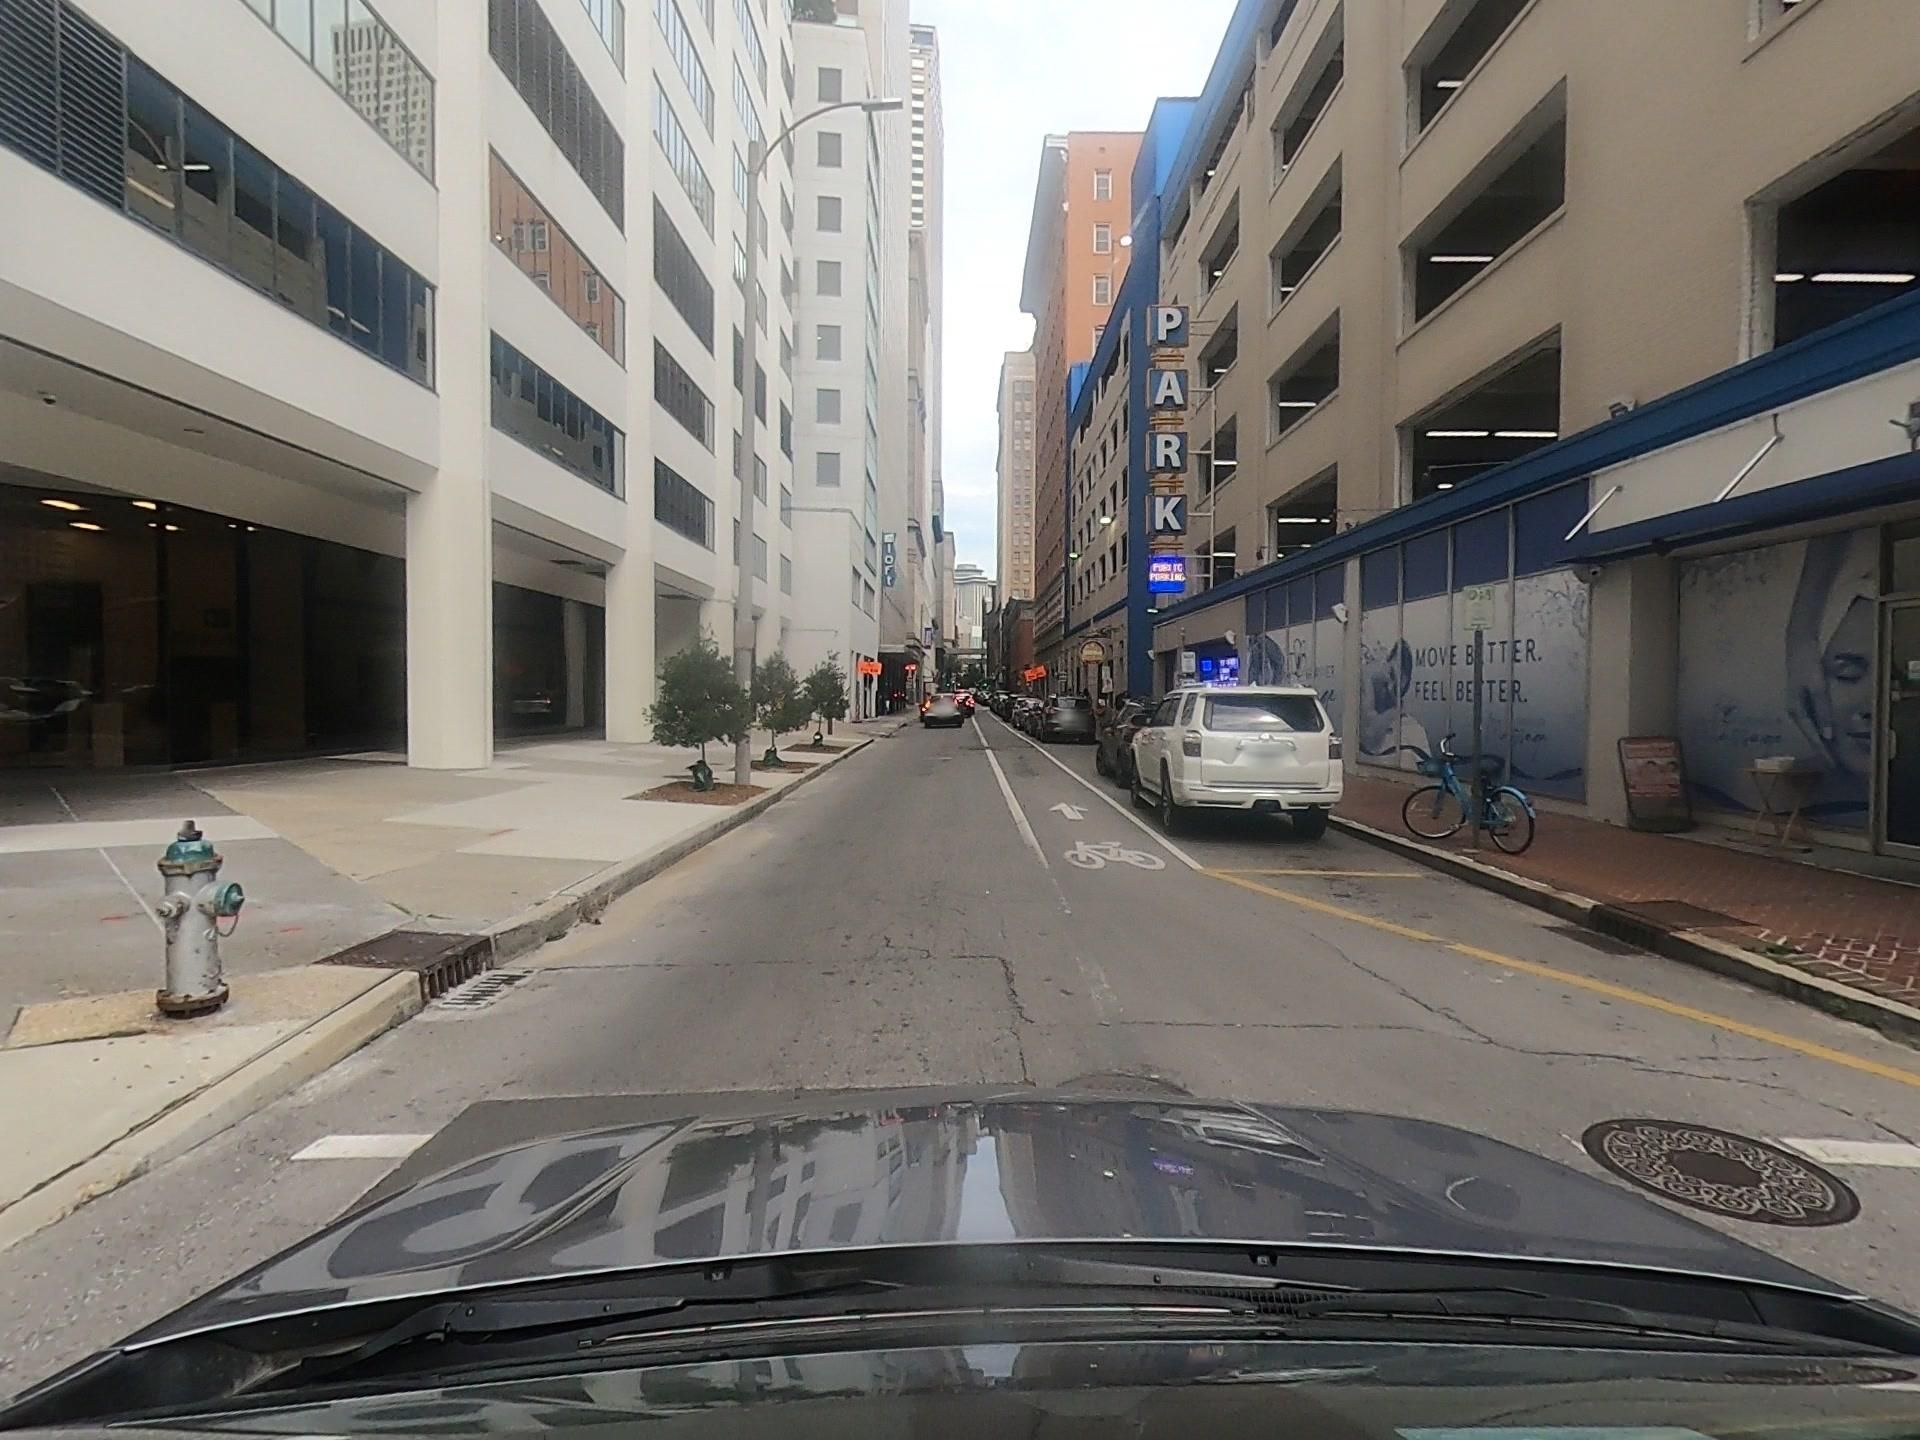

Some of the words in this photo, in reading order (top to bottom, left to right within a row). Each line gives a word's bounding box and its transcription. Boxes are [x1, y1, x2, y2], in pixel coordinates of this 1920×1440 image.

[1154, 307, 1185, 531] PARK
[1415, 645, 1457, 667] MOVE
[1465, 638, 1542, 666] BTTER.
[1415, 680, 1447, 701] FEEL
[1456, 679, 1528, 703] BETER.
